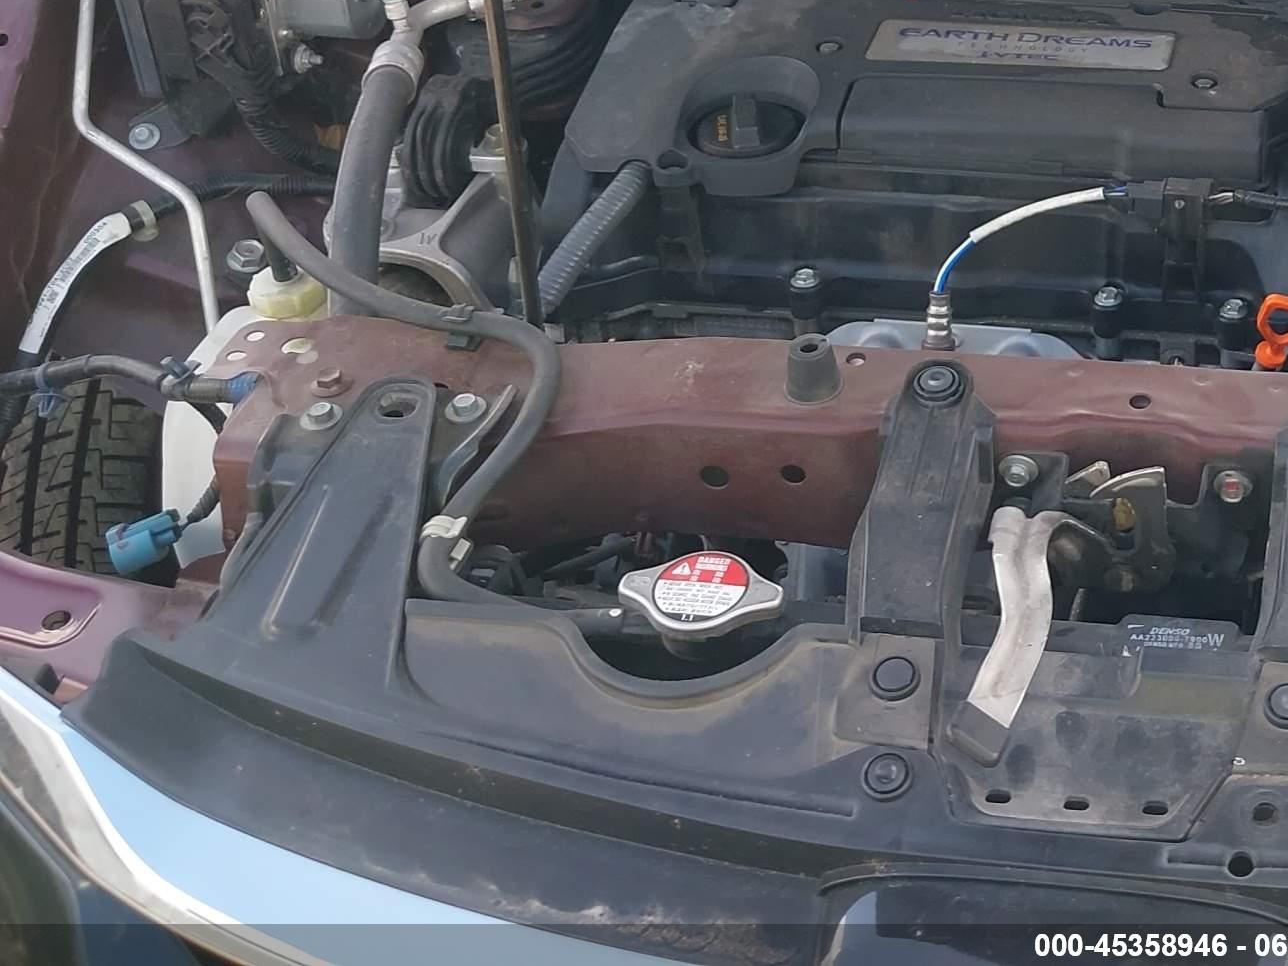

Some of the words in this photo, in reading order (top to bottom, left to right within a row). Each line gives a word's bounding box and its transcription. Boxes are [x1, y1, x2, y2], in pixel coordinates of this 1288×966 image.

[899, 27, 1009, 43] EARTH
[1017, 31, 1154, 49] DREAMS
[957, 41, 1090, 53] TECHNOLOGY
[1149, 627, 1191, 636] DENSO
